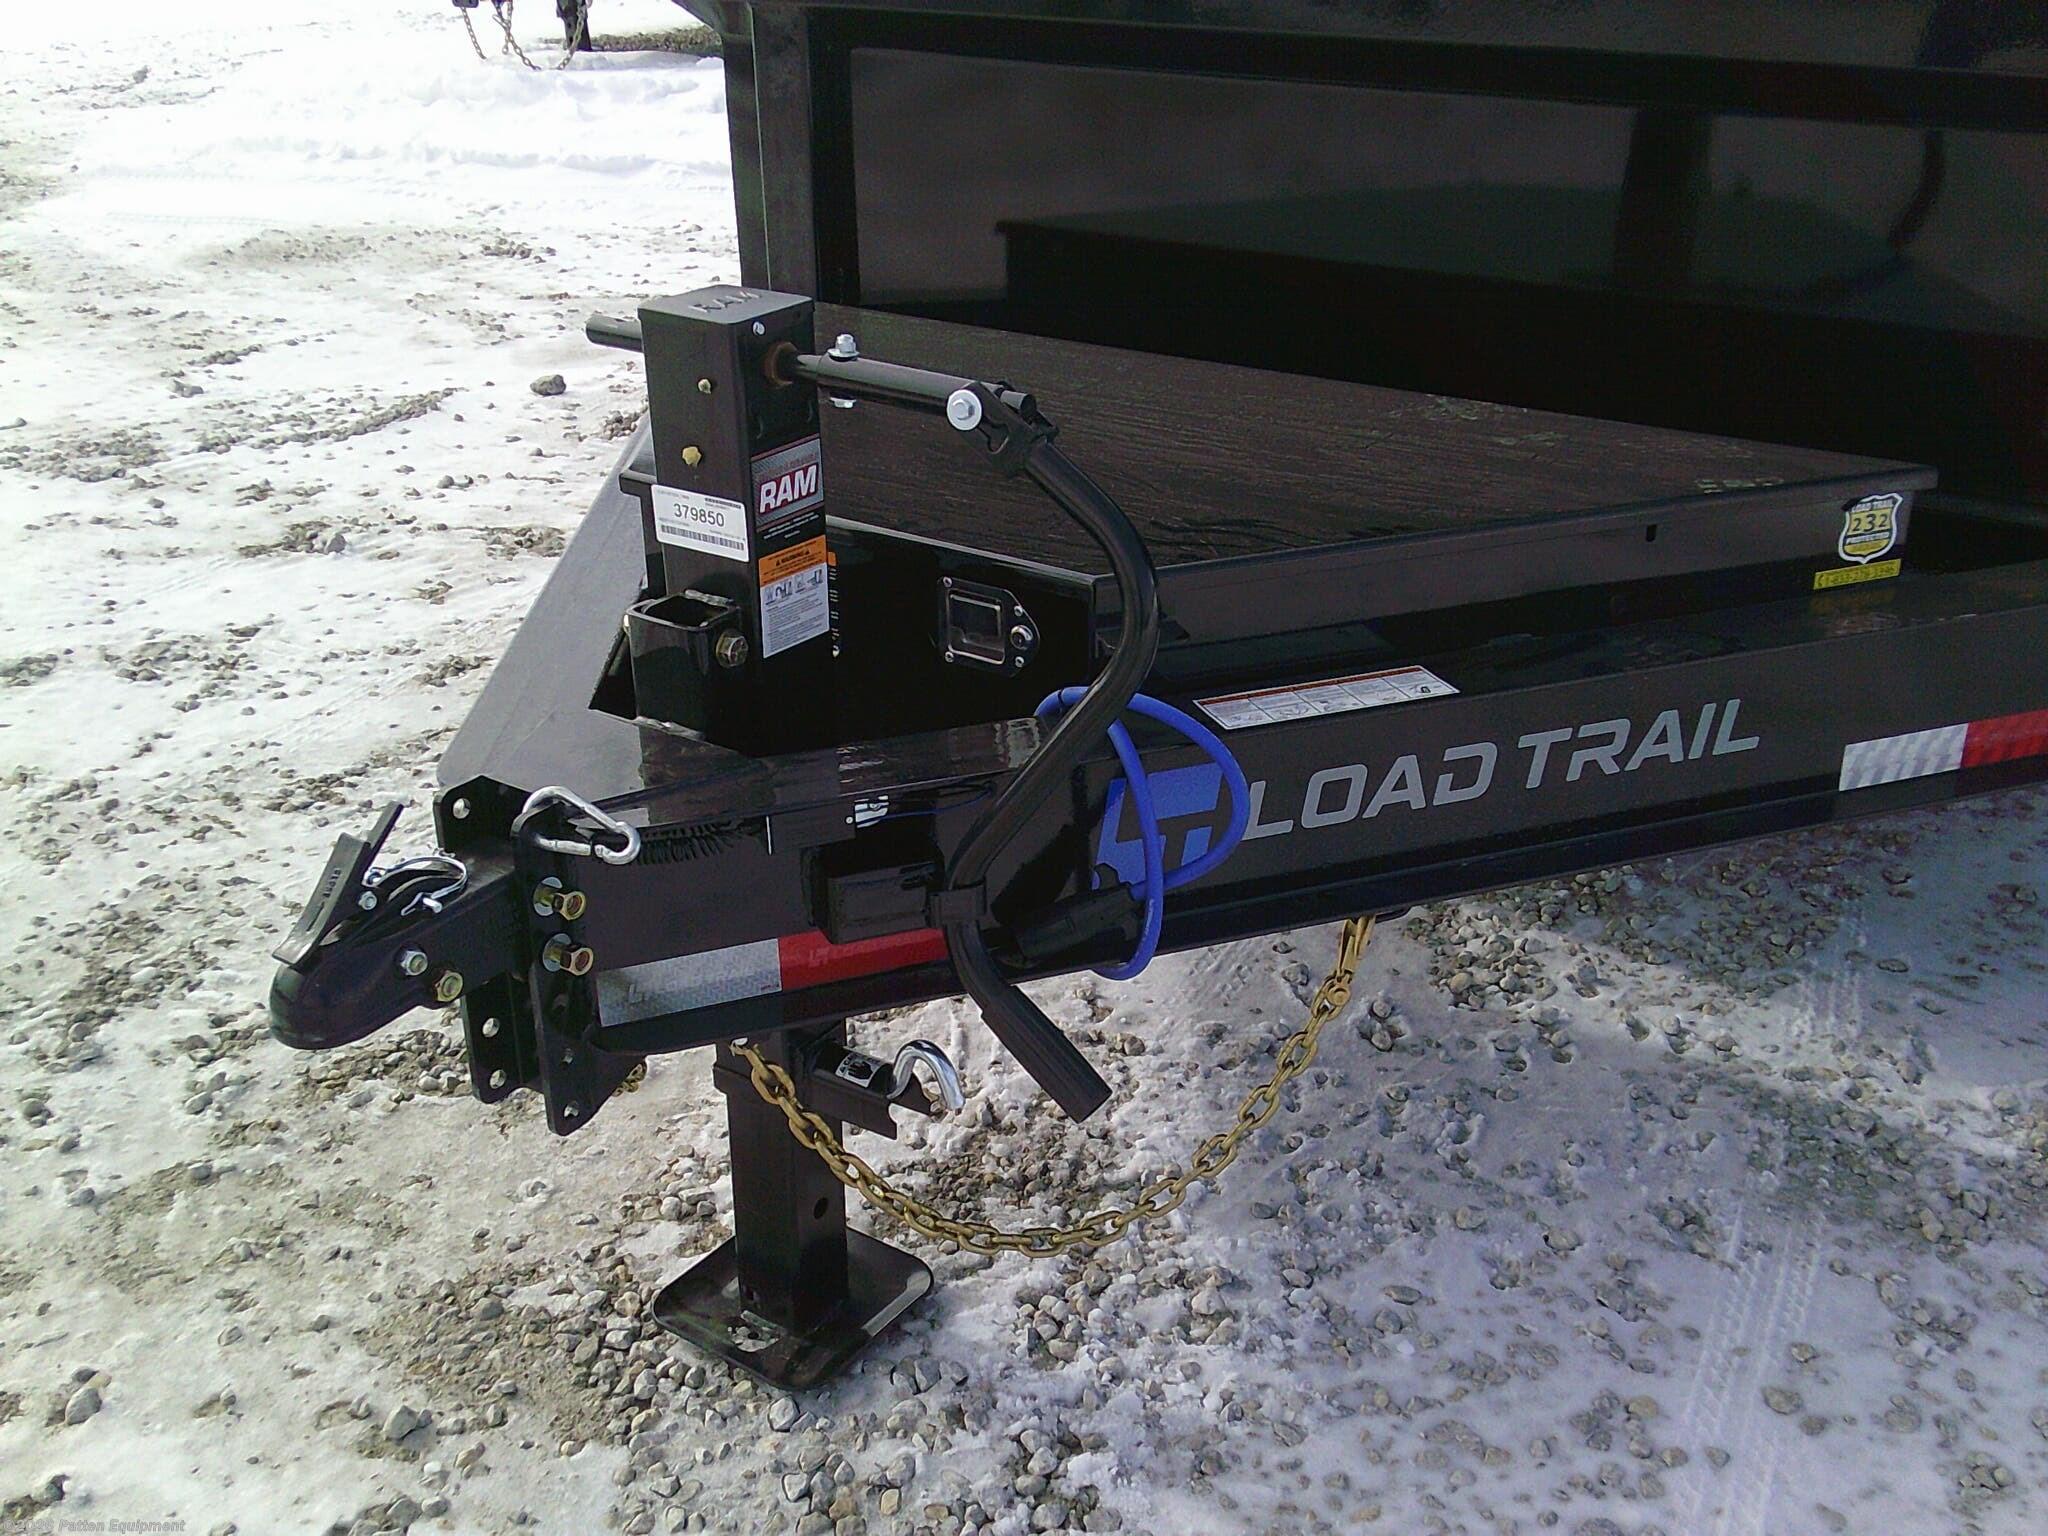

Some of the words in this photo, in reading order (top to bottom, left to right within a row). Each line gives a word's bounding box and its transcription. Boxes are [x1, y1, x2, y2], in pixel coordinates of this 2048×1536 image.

[688, 289, 761, 313] RAM
[759, 464, 818, 514] RAM
[673, 503, 725, 527] 379850
[1852, 513, 1888, 532] 232
[1241, 742, 1498, 841] LOAD
[1518, 699, 1760, 789] TRAIL
